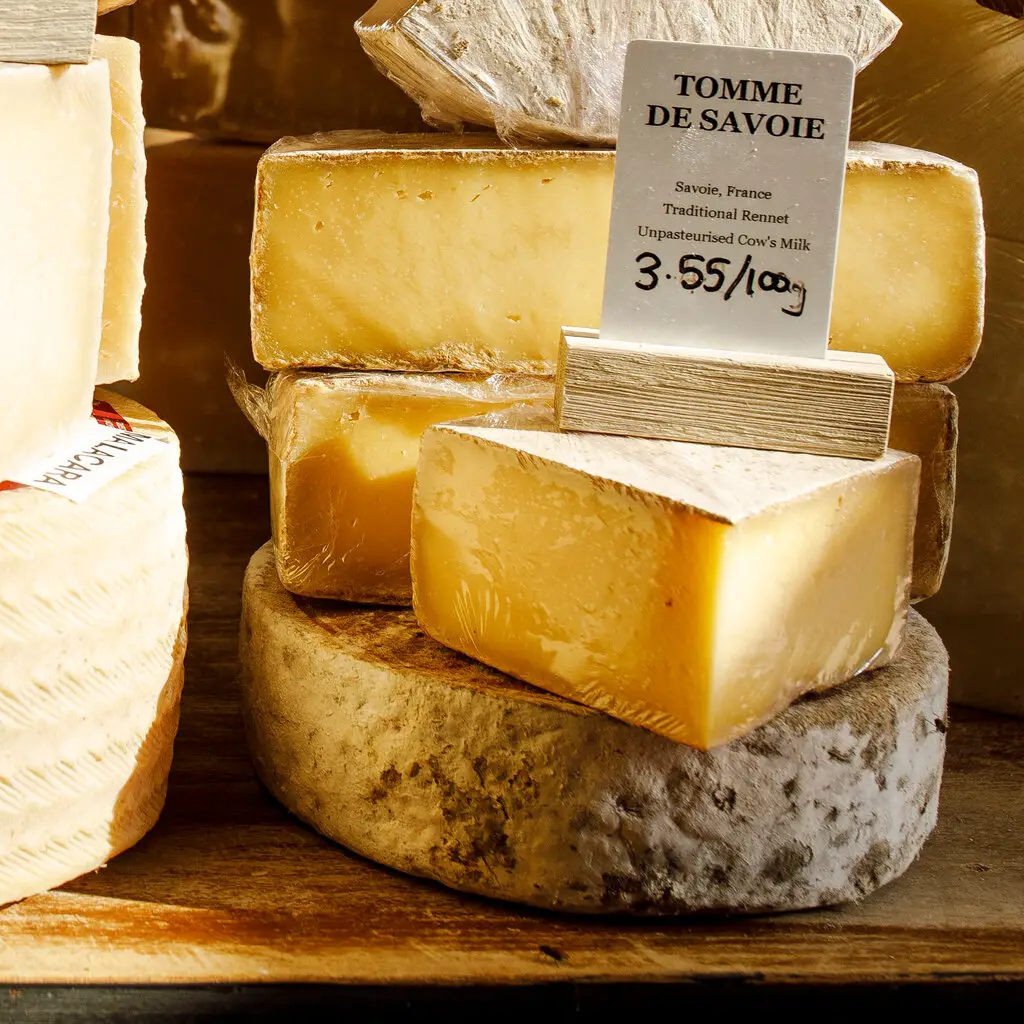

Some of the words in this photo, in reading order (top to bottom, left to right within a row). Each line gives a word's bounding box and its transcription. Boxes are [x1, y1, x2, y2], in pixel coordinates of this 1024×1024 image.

[674, 74, 802, 106] TOMME
[646, 104, 692, 128] DE
[699, 108, 825, 140] SAVOIE
[675, 181, 722, 197] Savoie,
[727, 185, 772, 200] France
[663, 203, 737, 221] Traditional
[742, 210, 789, 225] Rennet
[637, 226, 734, 245] Unpasteurised
[738, 234, 777, 248] Cow's
[780, 238, 811, 252] Milk
[634, 251, 807, 317] 3.55/100g
